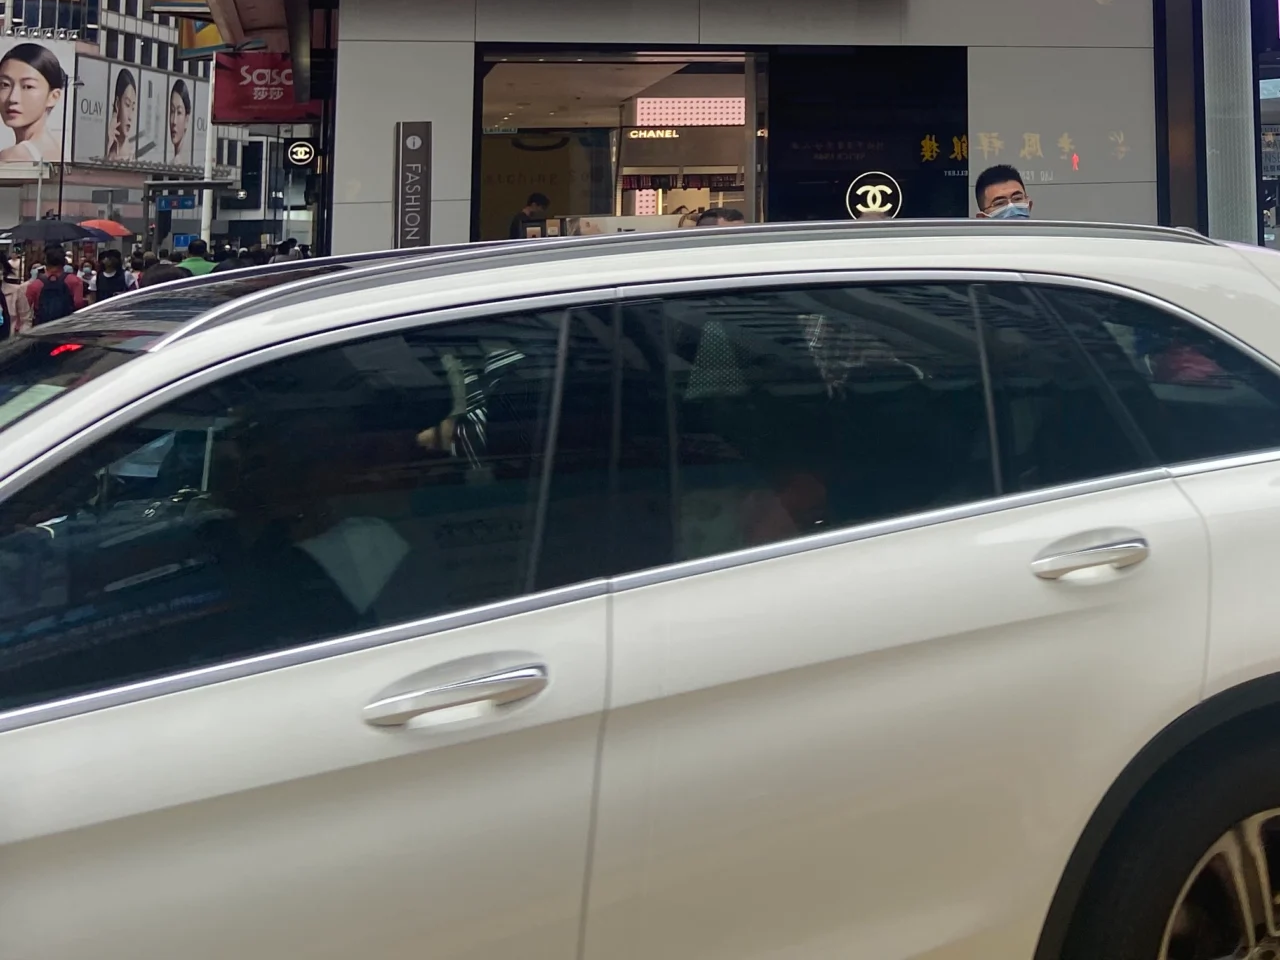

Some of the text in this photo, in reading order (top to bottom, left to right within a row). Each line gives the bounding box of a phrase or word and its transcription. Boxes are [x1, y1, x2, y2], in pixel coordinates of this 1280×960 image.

[80, 98, 104, 117] OLAY
[629, 129, 680, 139] CHANEL
[404, 164, 422, 240] FASHION
